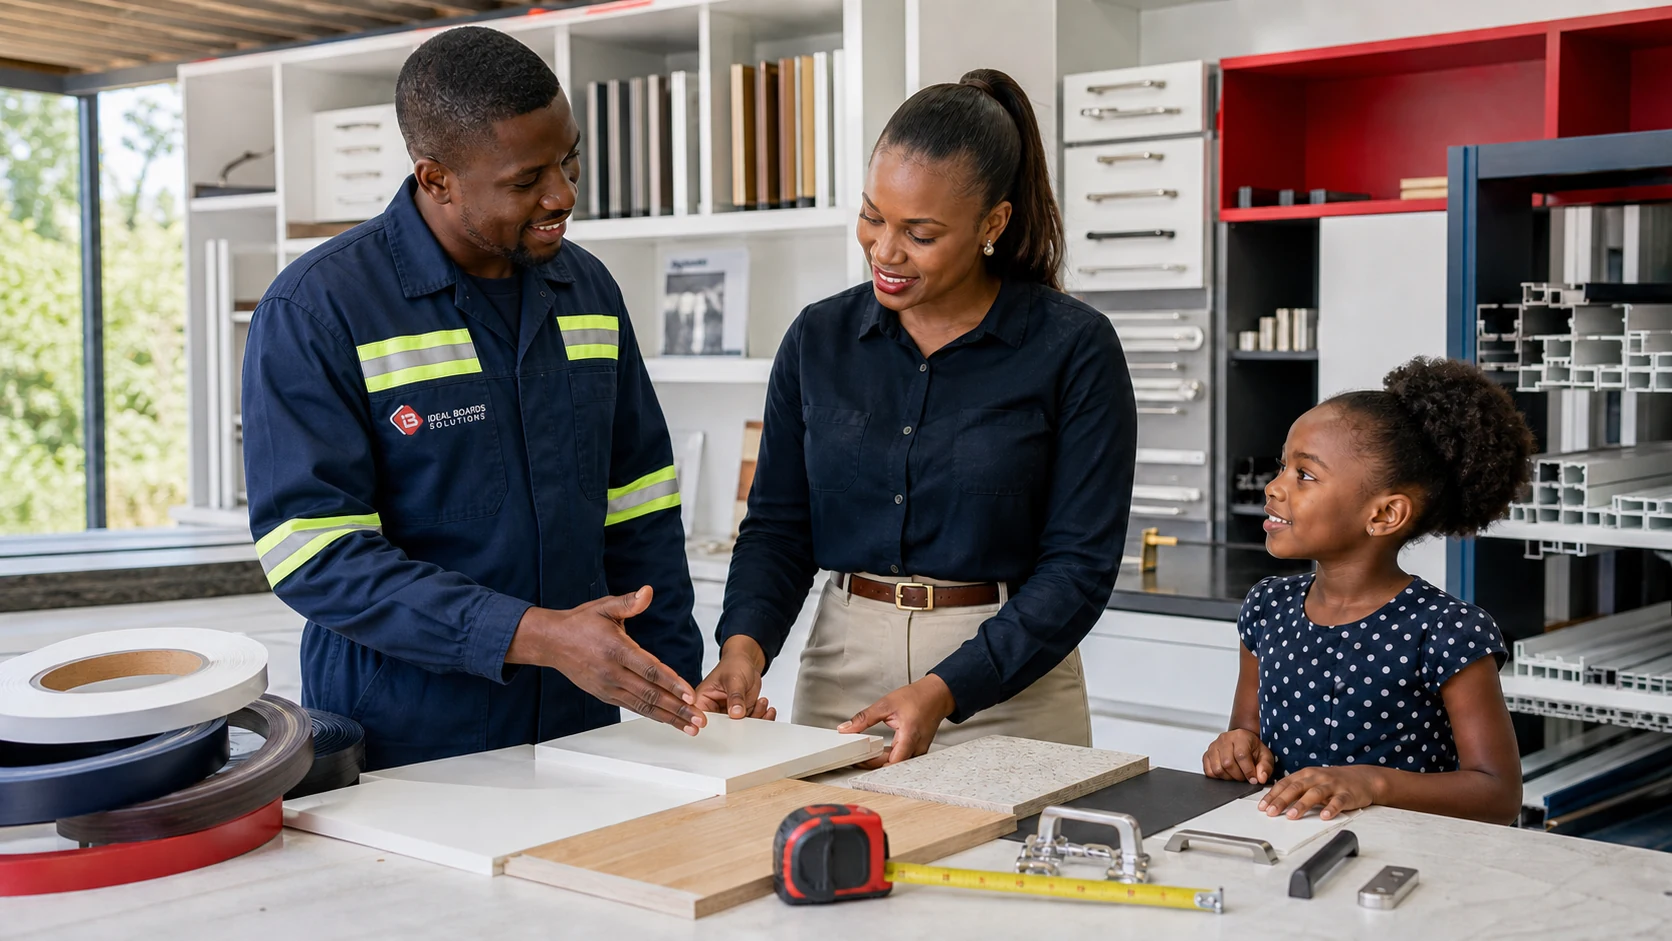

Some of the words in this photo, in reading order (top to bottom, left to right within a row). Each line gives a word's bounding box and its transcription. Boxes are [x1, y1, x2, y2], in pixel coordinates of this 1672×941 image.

[427, 411, 451, 423] IDEAL
[453, 404, 486, 418] BOARDS
[429, 412, 486, 430] SOLUTIONS
